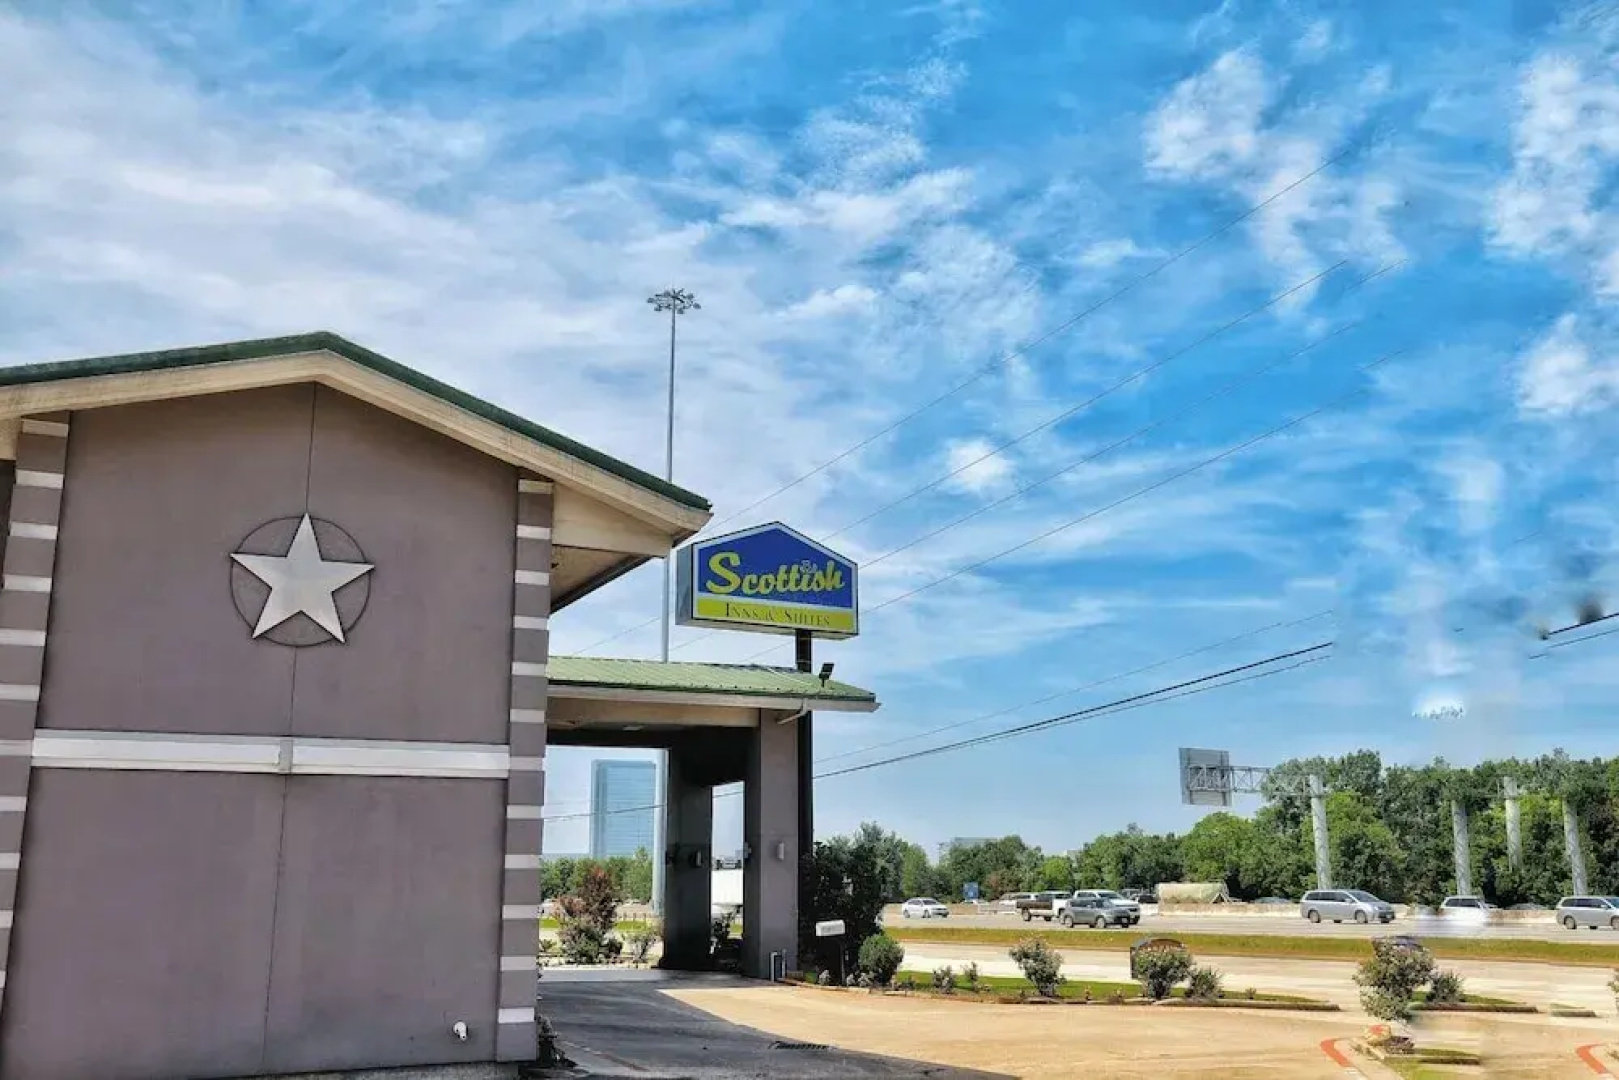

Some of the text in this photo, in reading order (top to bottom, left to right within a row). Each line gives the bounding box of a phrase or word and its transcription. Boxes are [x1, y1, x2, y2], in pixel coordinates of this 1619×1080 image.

[706, 552, 845, 594] Scottish
[726, 603, 758, 618] INNS
[785, 609, 830, 626] SUITES
